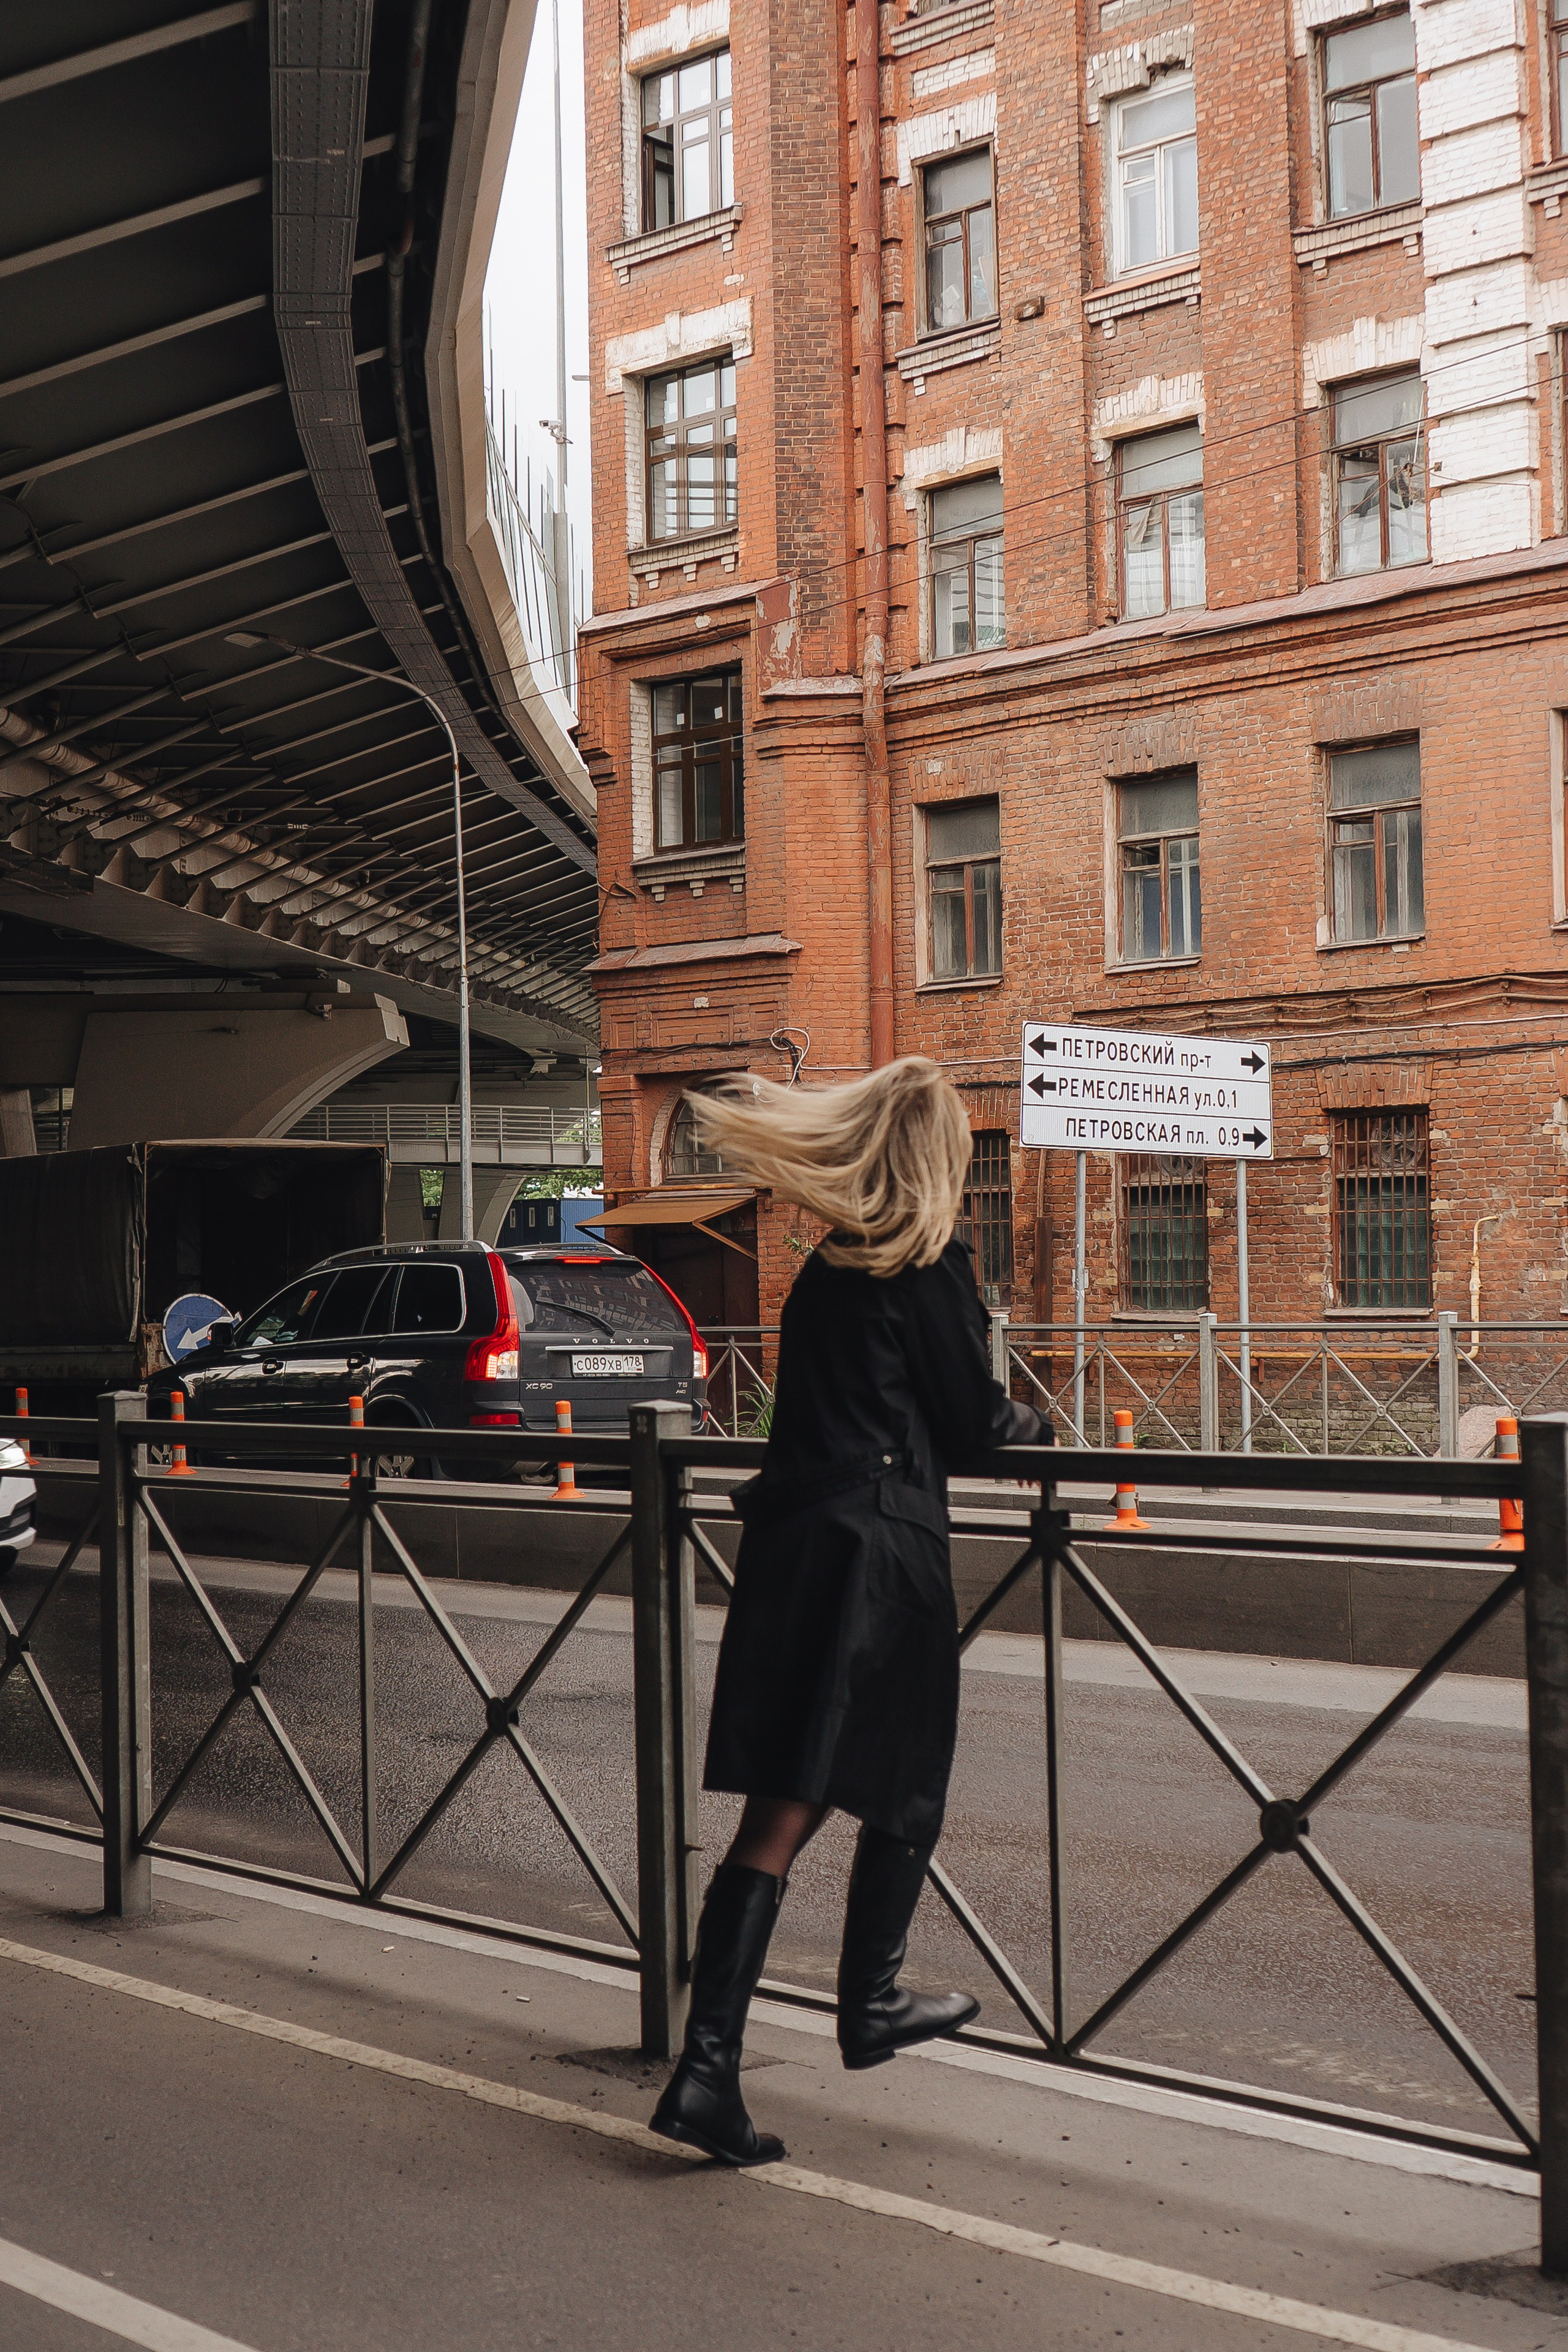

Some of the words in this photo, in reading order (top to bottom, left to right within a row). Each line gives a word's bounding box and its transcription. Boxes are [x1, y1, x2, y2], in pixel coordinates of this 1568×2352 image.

[1062, 1038, 1174, 1066] ПЕТРОВСКИЙ
[1181, 1052, 1212, 1072] пр-т
[1059, 1077, 1189, 1105] РЕМЕСЛЕННАЯ
[1066, 1118, 1180, 1143] ПЕТРОВСКАЯ
[1186, 1130, 1208, 1145] пл.
[1218, 1127, 1239, 1148] 0,9
[624, 1356, 640, 1366] 178
